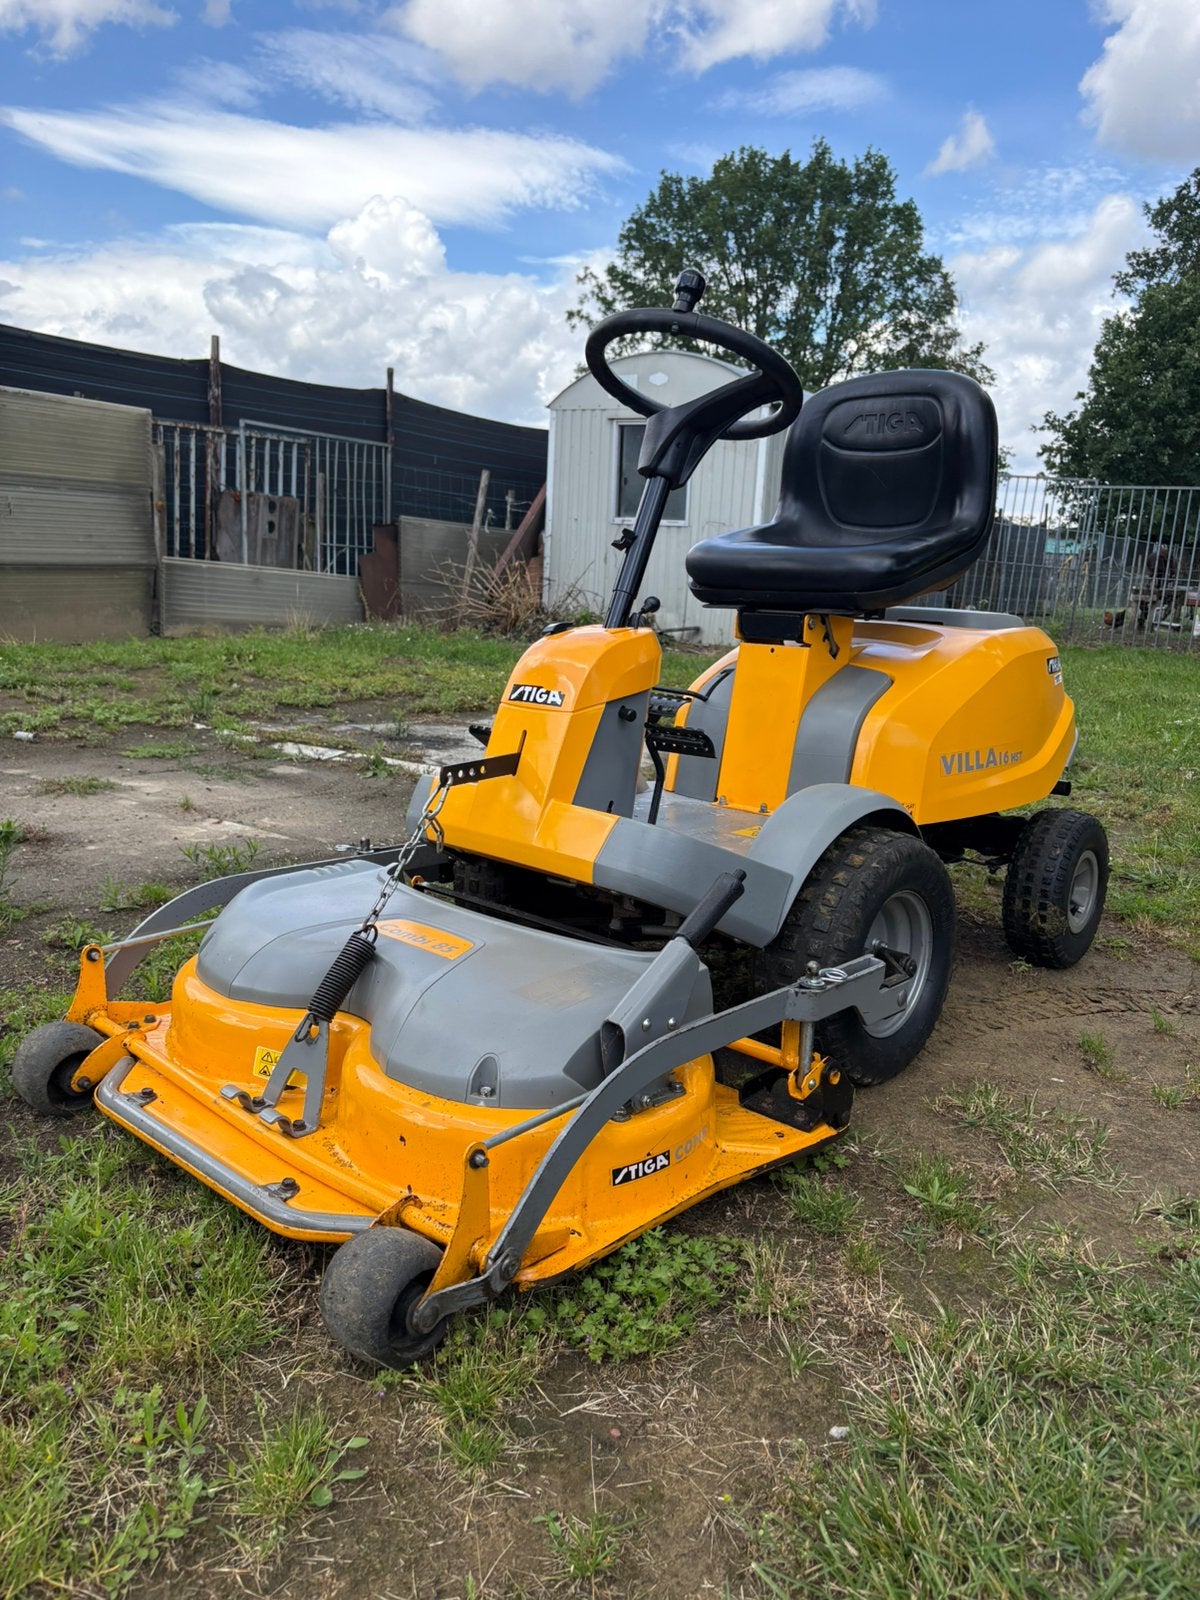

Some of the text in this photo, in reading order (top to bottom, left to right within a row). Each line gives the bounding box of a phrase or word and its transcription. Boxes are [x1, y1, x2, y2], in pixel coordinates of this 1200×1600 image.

[843, 411, 924, 436] STIGA
[510, 686, 562, 705] STIGA
[941, 748, 997, 775] VILLA
[998, 751, 1009, 765] 16
[379, 923, 460, 954] Combi 85
[614, 1153, 669, 1185] STIGA
